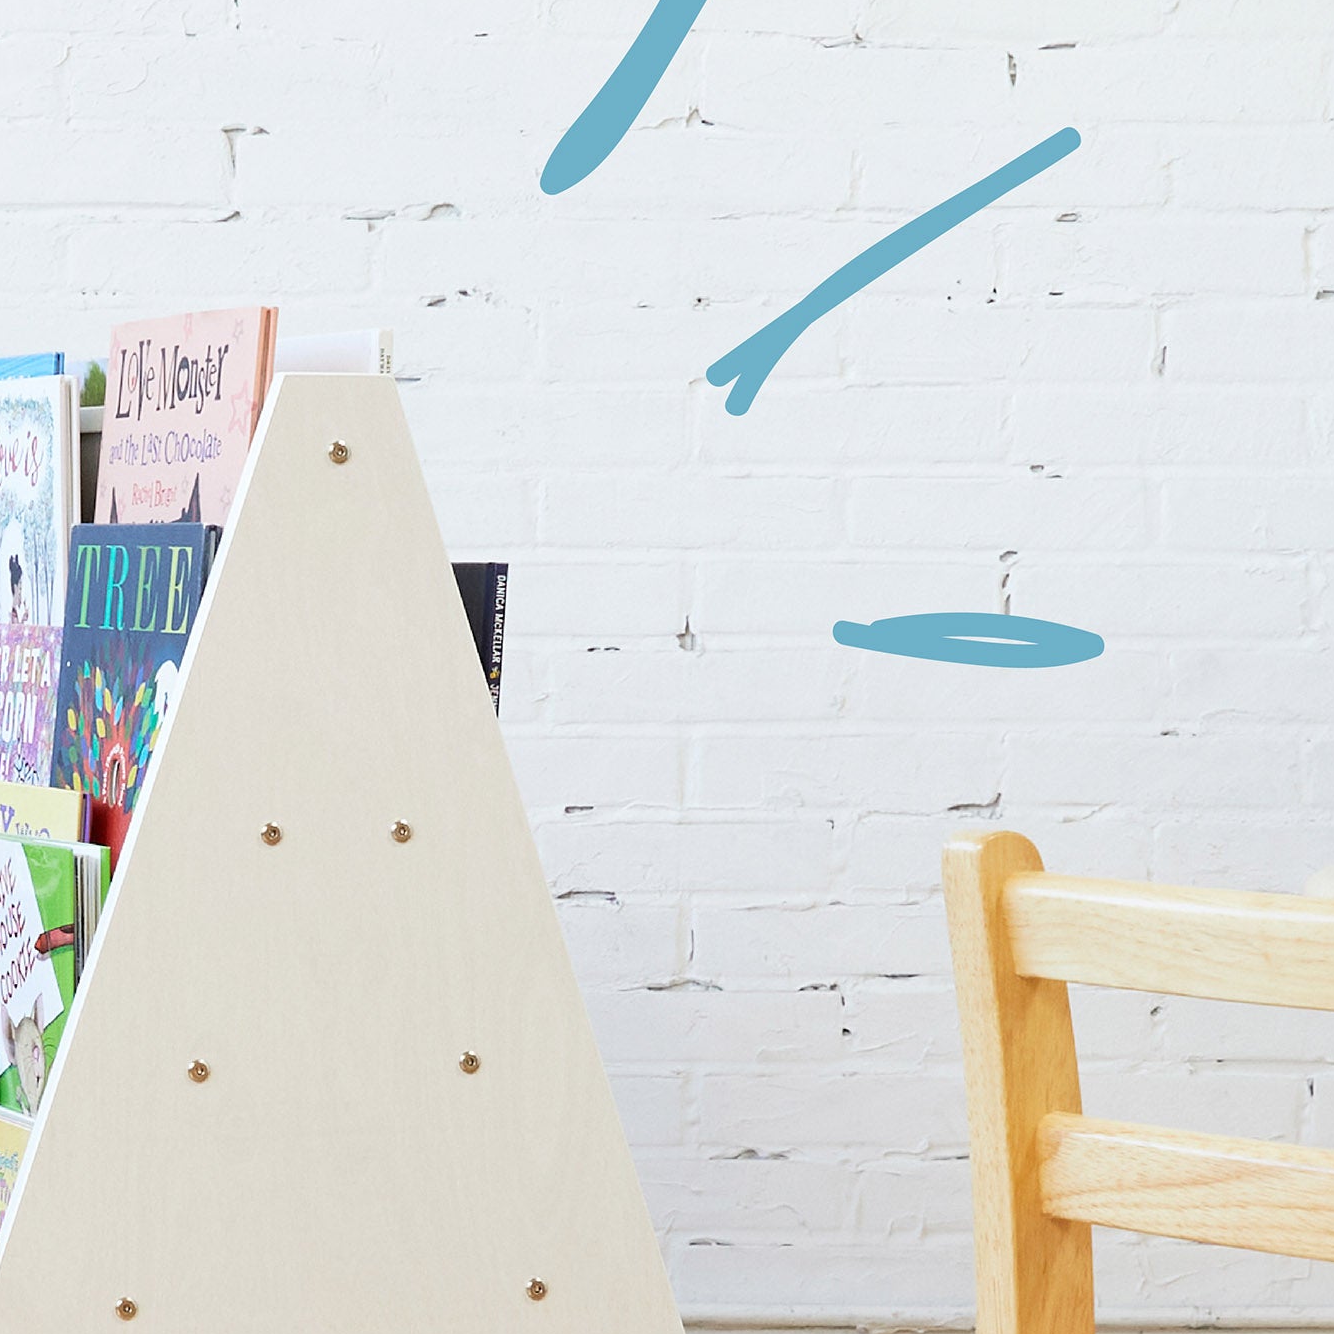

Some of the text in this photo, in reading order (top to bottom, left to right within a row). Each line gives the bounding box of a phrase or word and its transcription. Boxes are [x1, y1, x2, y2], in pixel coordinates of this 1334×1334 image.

[156, 344, 229, 415] Monster
[24, 431, 44, 486] is
[124, 434, 139, 466] the
[164, 429, 222, 465] Chocolate
[74, 544, 193, 634] TREE
[495, 574, 507, 611] DANICA
[13, 643, 41, 683] LET
[41, 651, 51, 688] A
[0, 936, 35, 1004] COOKIE
